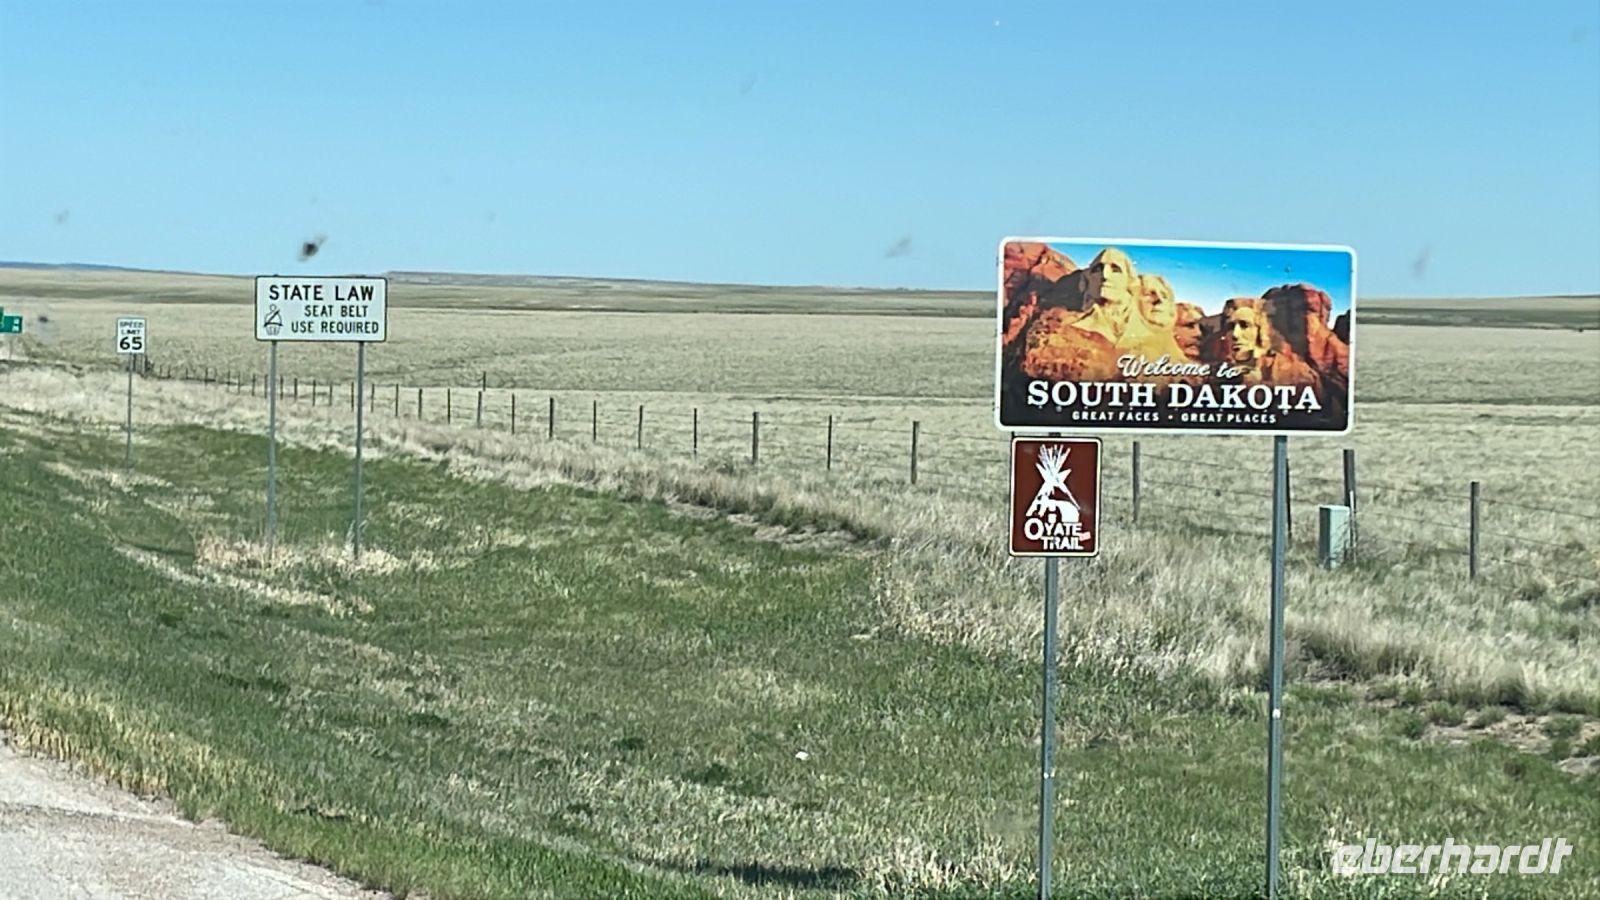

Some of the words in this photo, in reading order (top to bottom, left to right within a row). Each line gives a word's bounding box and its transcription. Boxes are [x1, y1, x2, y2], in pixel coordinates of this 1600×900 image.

[269, 285, 324, 301] STATE
[335, 285, 374, 301] LAW
[304, 305, 334, 317] SEAT
[341, 305, 368, 317] BELT
[291, 321, 315, 333] USE
[321, 321, 379, 334] REQUIRED
[120, 336, 143, 350] 65
[1116, 354, 1211, 378] Welcome
[1216, 361, 1245, 378] to
[1027, 380, 1156, 407] SOUTH
[1168, 383, 1322, 410] DAKOTA
[1072, 411, 1115, 421] GREAT
[1118, 411, 1160, 422] FACES
[1181, 412, 1224, 423] GREAT
[1227, 413, 1277, 423] PLACES
[1024, 518, 1083, 540] OYATE
[1040, 536, 1084, 550] TRAIL
